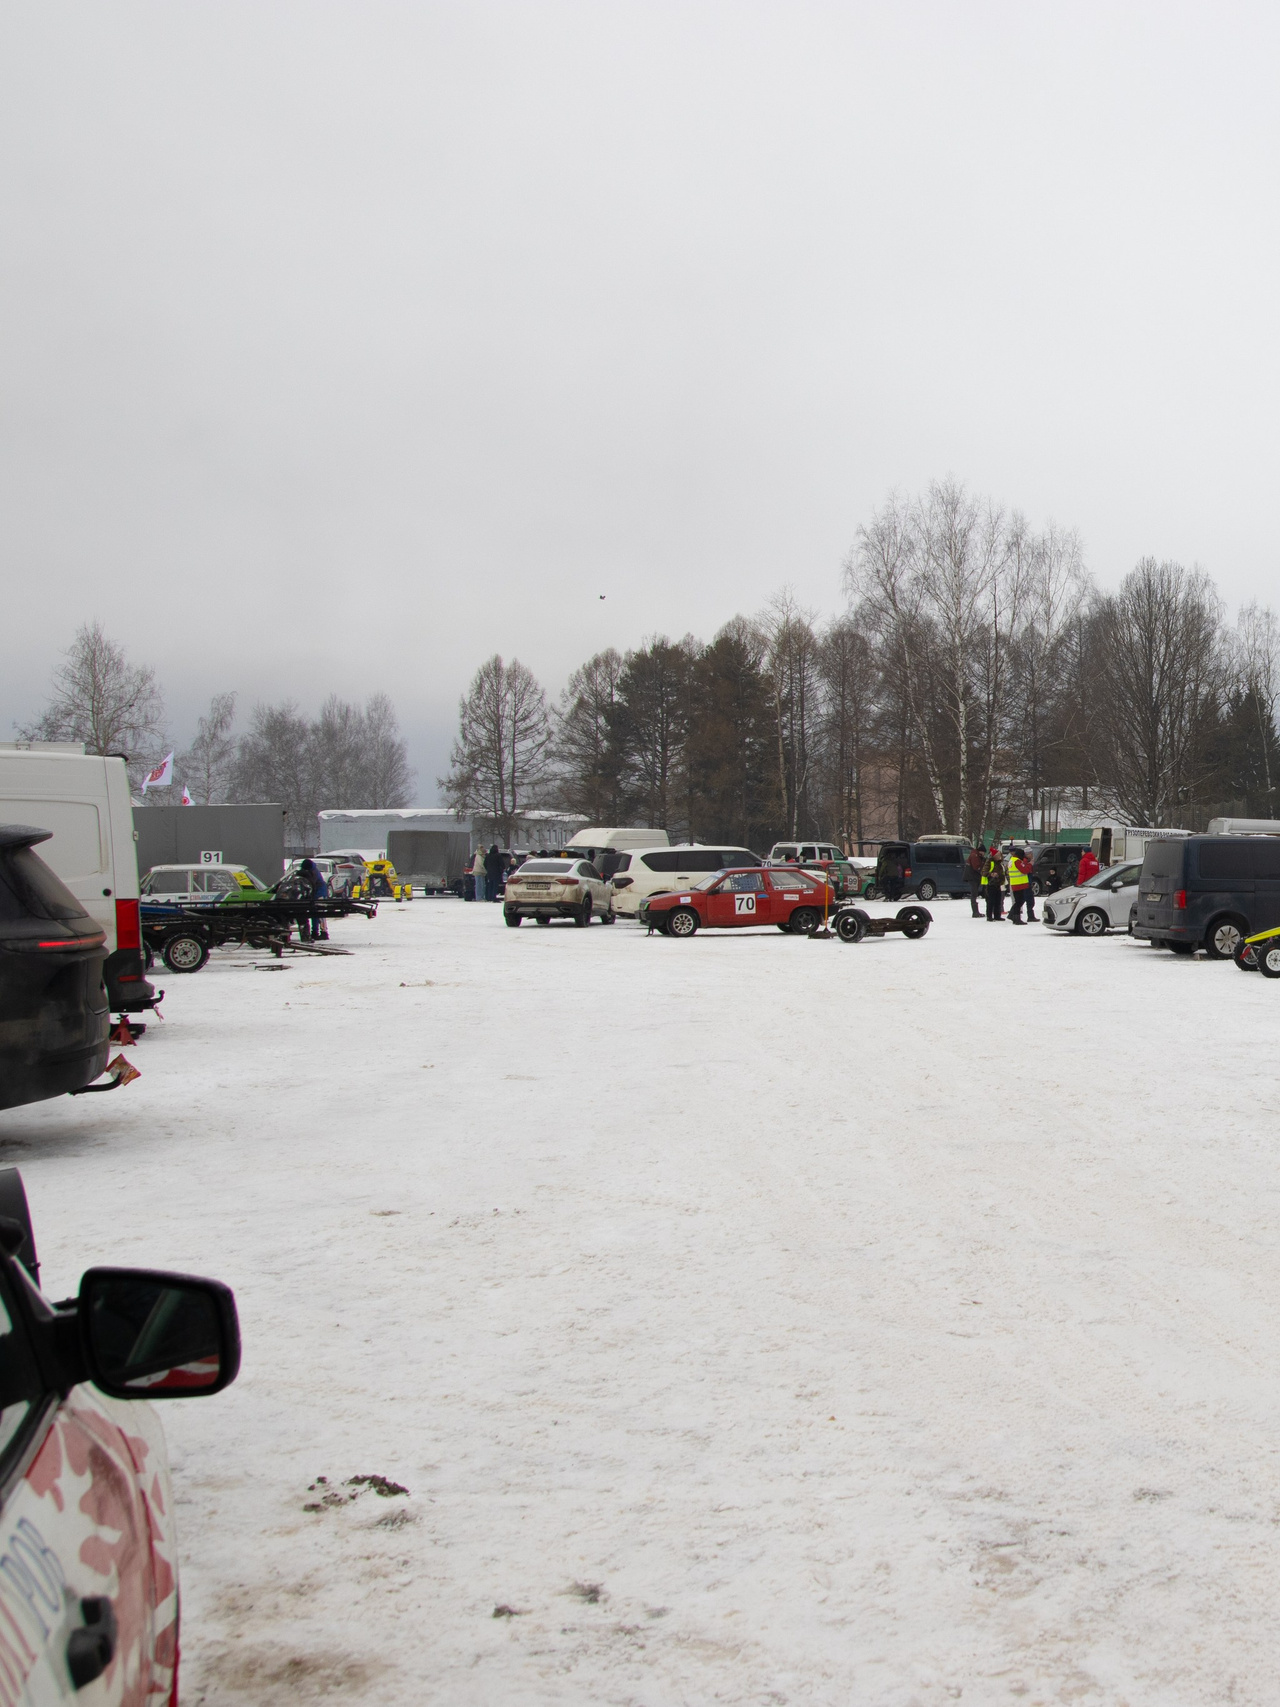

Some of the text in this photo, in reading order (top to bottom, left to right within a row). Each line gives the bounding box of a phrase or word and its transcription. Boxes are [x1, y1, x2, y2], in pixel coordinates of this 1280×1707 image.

[203, 852, 221, 863] 91
[762, 860, 772, 868] 70
[735, 896, 756, 911] 70
